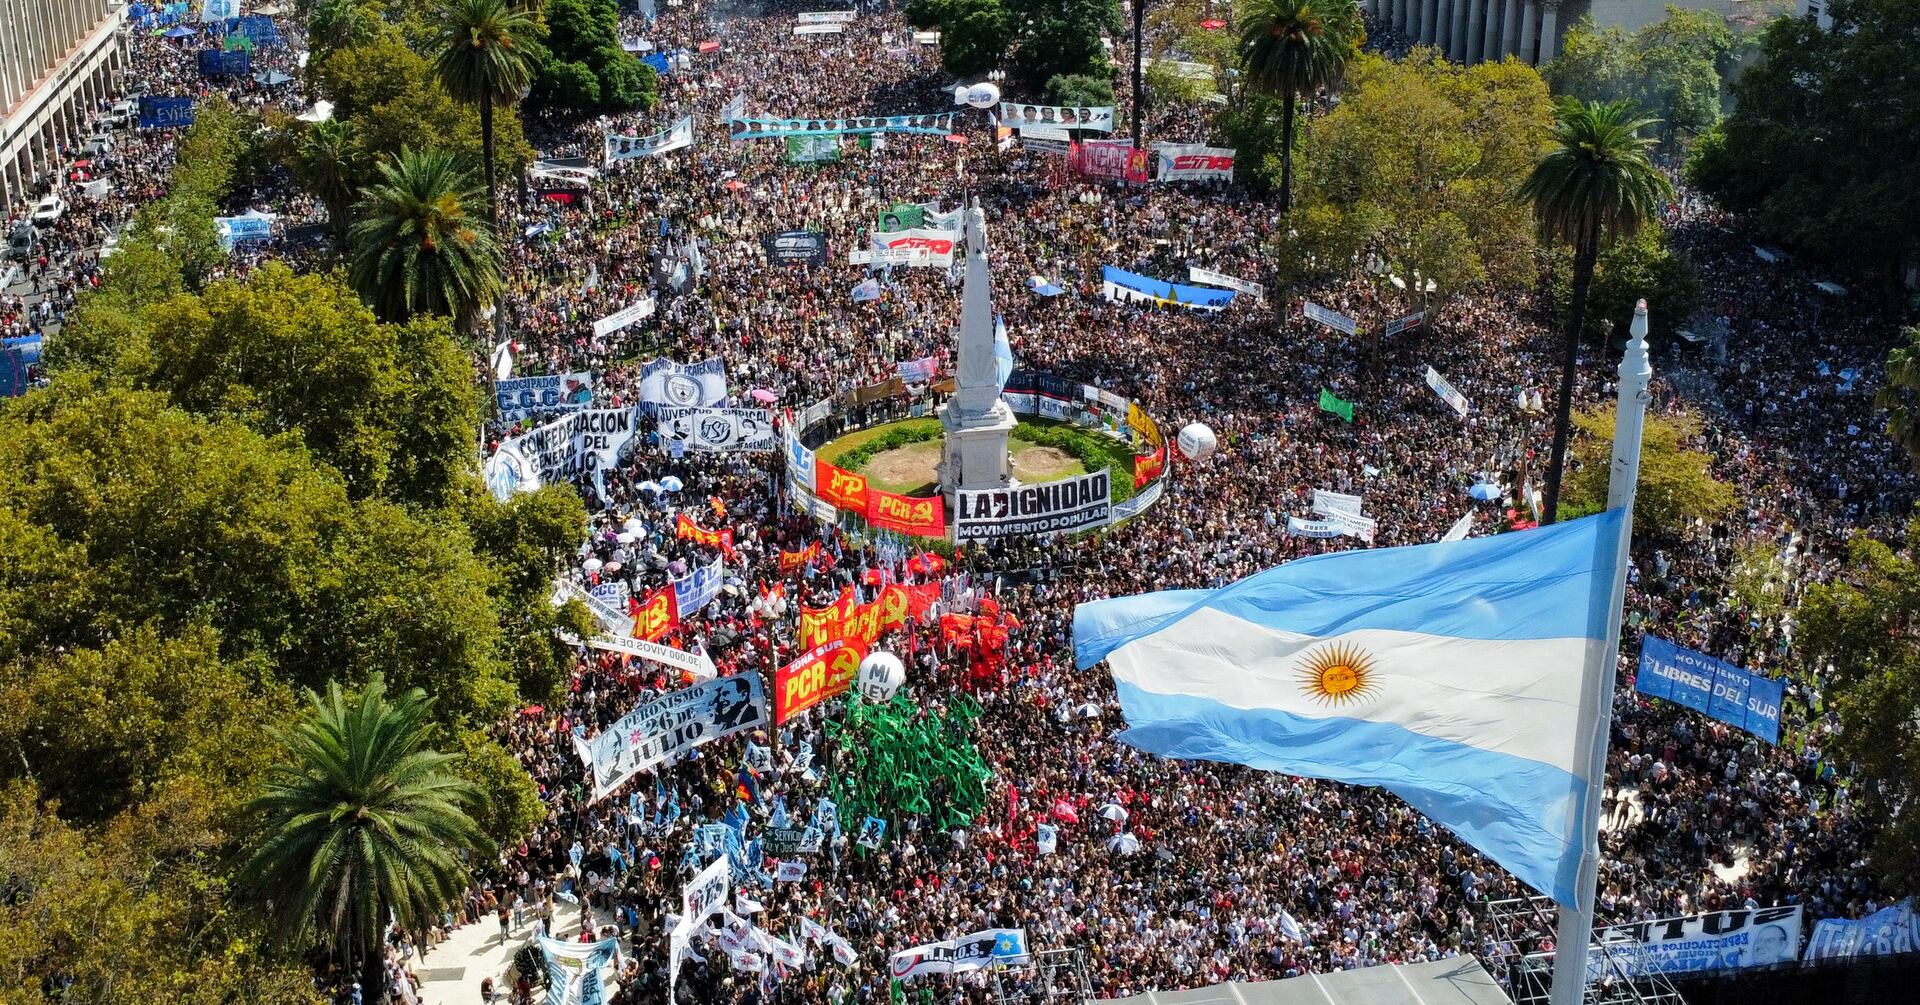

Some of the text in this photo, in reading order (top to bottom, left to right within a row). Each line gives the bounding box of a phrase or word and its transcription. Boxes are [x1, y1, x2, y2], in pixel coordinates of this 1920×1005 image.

[496, 376, 560, 391] DESOCUPADOS
[660, 408, 713, 422] JUVENTUD
[721, 408, 770, 424] SINDICAL
[519, 411, 629, 459] CONFEDERACION
[584, 435, 610, 450] DEL
[688, 437, 773, 451] UNIDOS TRIUNFAREMOS
[530, 441, 577, 474] GENERAL
[878, 496, 910, 519] PCR
[993, 473, 1107, 518] DIGNIDAD
[959, 506, 1108, 539] MOVIMIENTO POPULAR
[790, 639, 844, 673] ZONA SUR
[1675, 653, 1750, 687] MOVIMIENTO
[785, 660, 826, 709] PCR
[868, 663, 891, 683] MI
[862, 682, 890, 700] LEY
[1653, 660, 1777, 721] LIBRES DEL SUR
[624, 687, 704, 730] PERONISMO
[645, 707, 696, 739] 26 DE
[629, 721, 704, 769] JULIO
